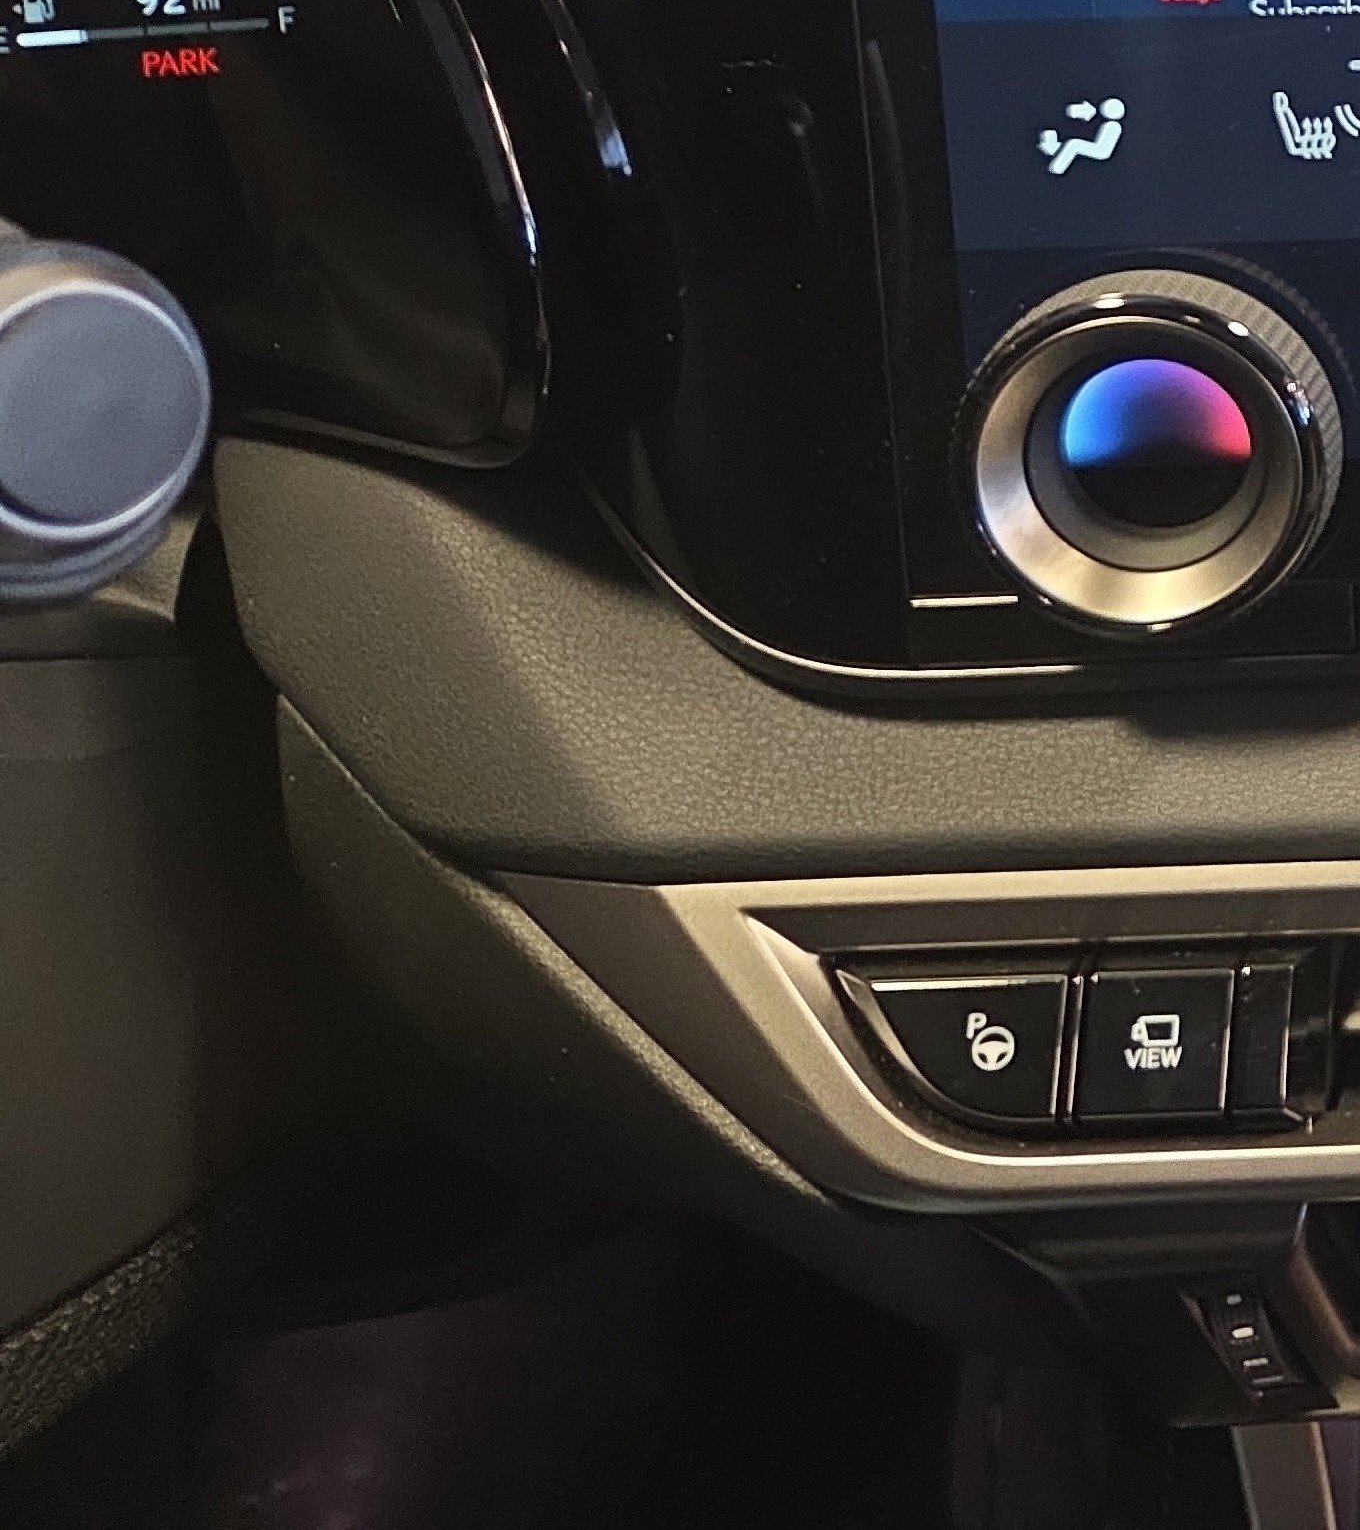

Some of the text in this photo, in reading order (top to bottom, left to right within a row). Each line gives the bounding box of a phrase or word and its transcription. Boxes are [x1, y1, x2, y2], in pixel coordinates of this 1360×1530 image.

[278, 6, 295, 34] F
[141, 47, 220, 77] PARK
[1123, 1046, 1182, 1070] VIEW
